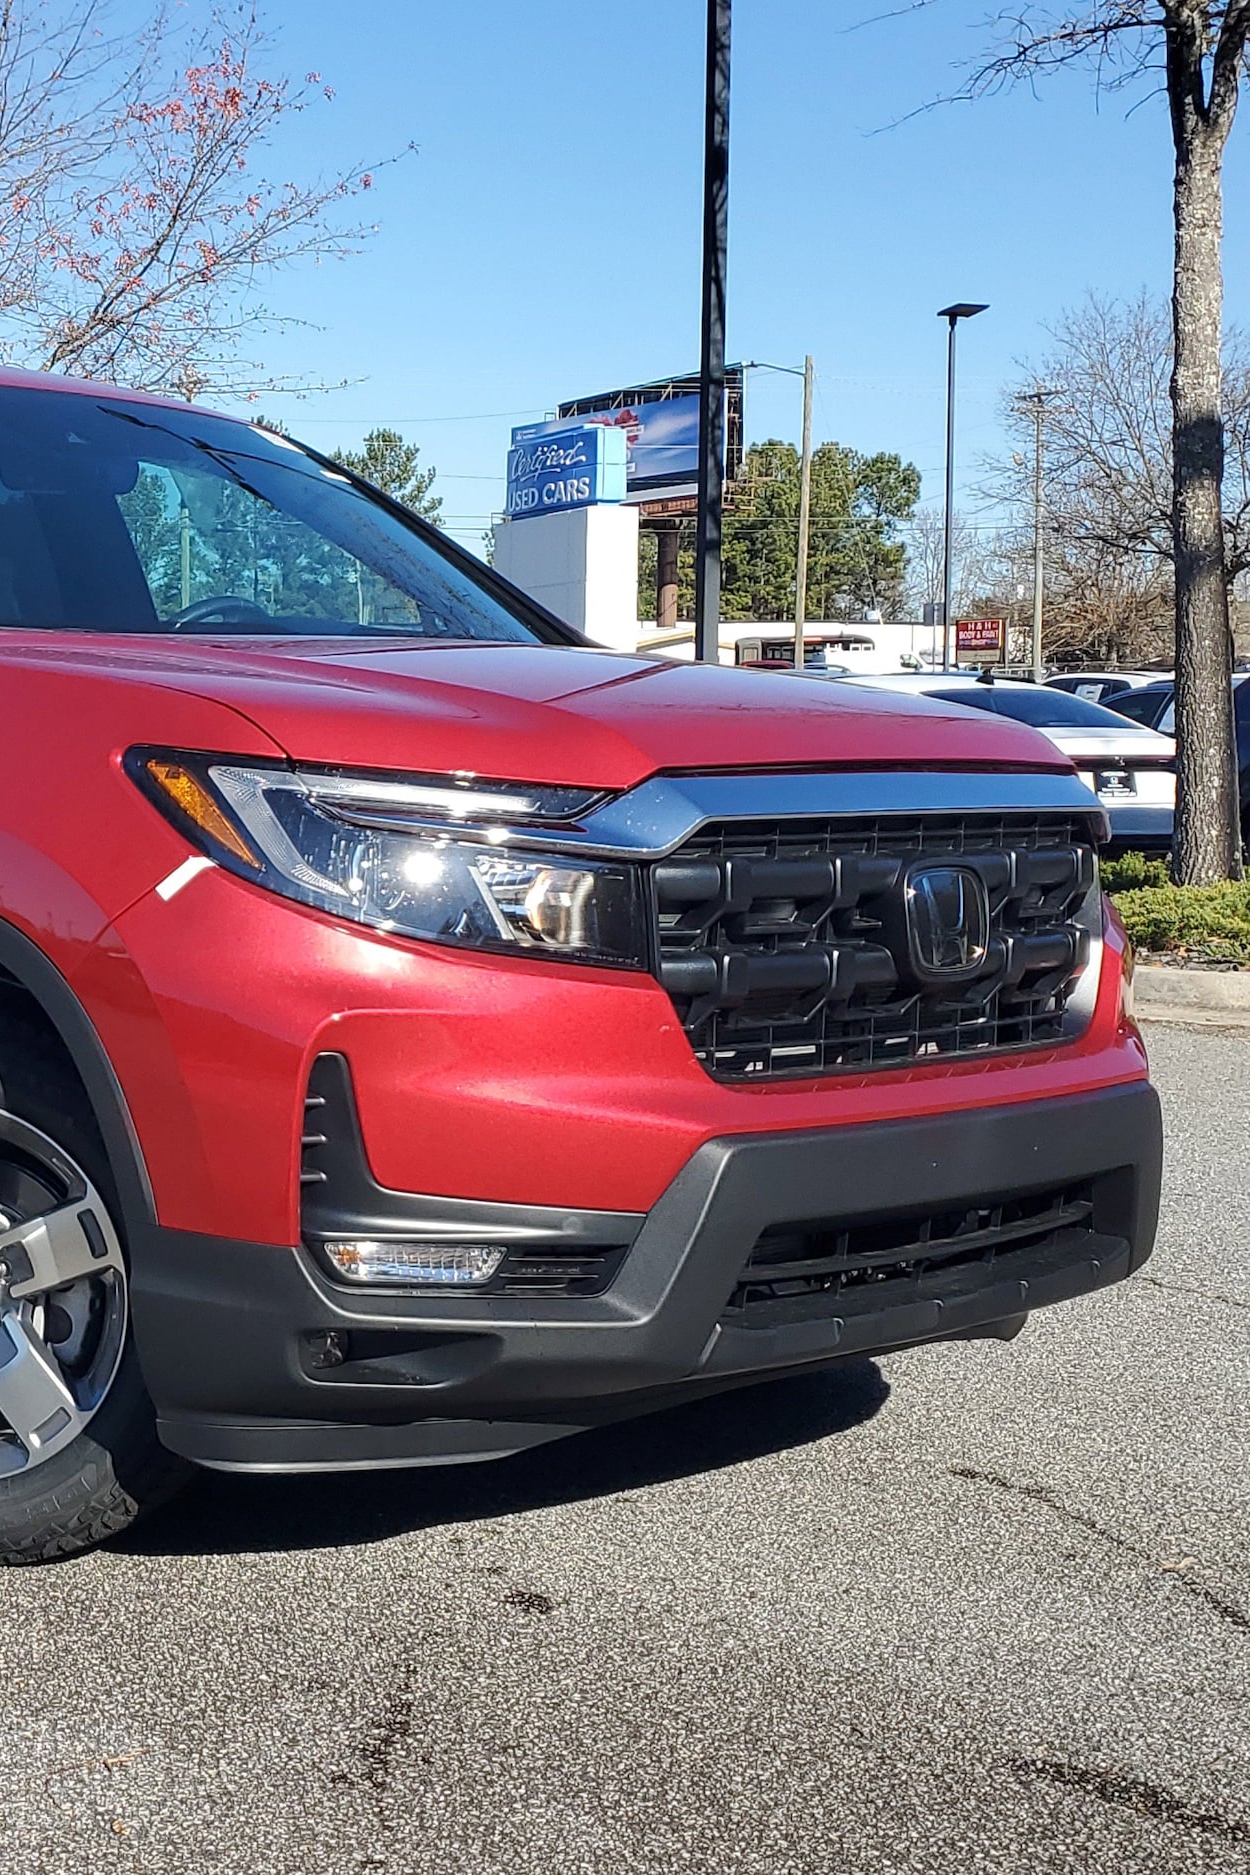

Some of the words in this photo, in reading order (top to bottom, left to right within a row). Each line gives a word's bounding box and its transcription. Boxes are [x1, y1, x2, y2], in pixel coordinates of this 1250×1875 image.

[512, 442, 586, 480] Certified
[508, 487, 539, 512] USED
[542, 477, 590, 504] CARS
